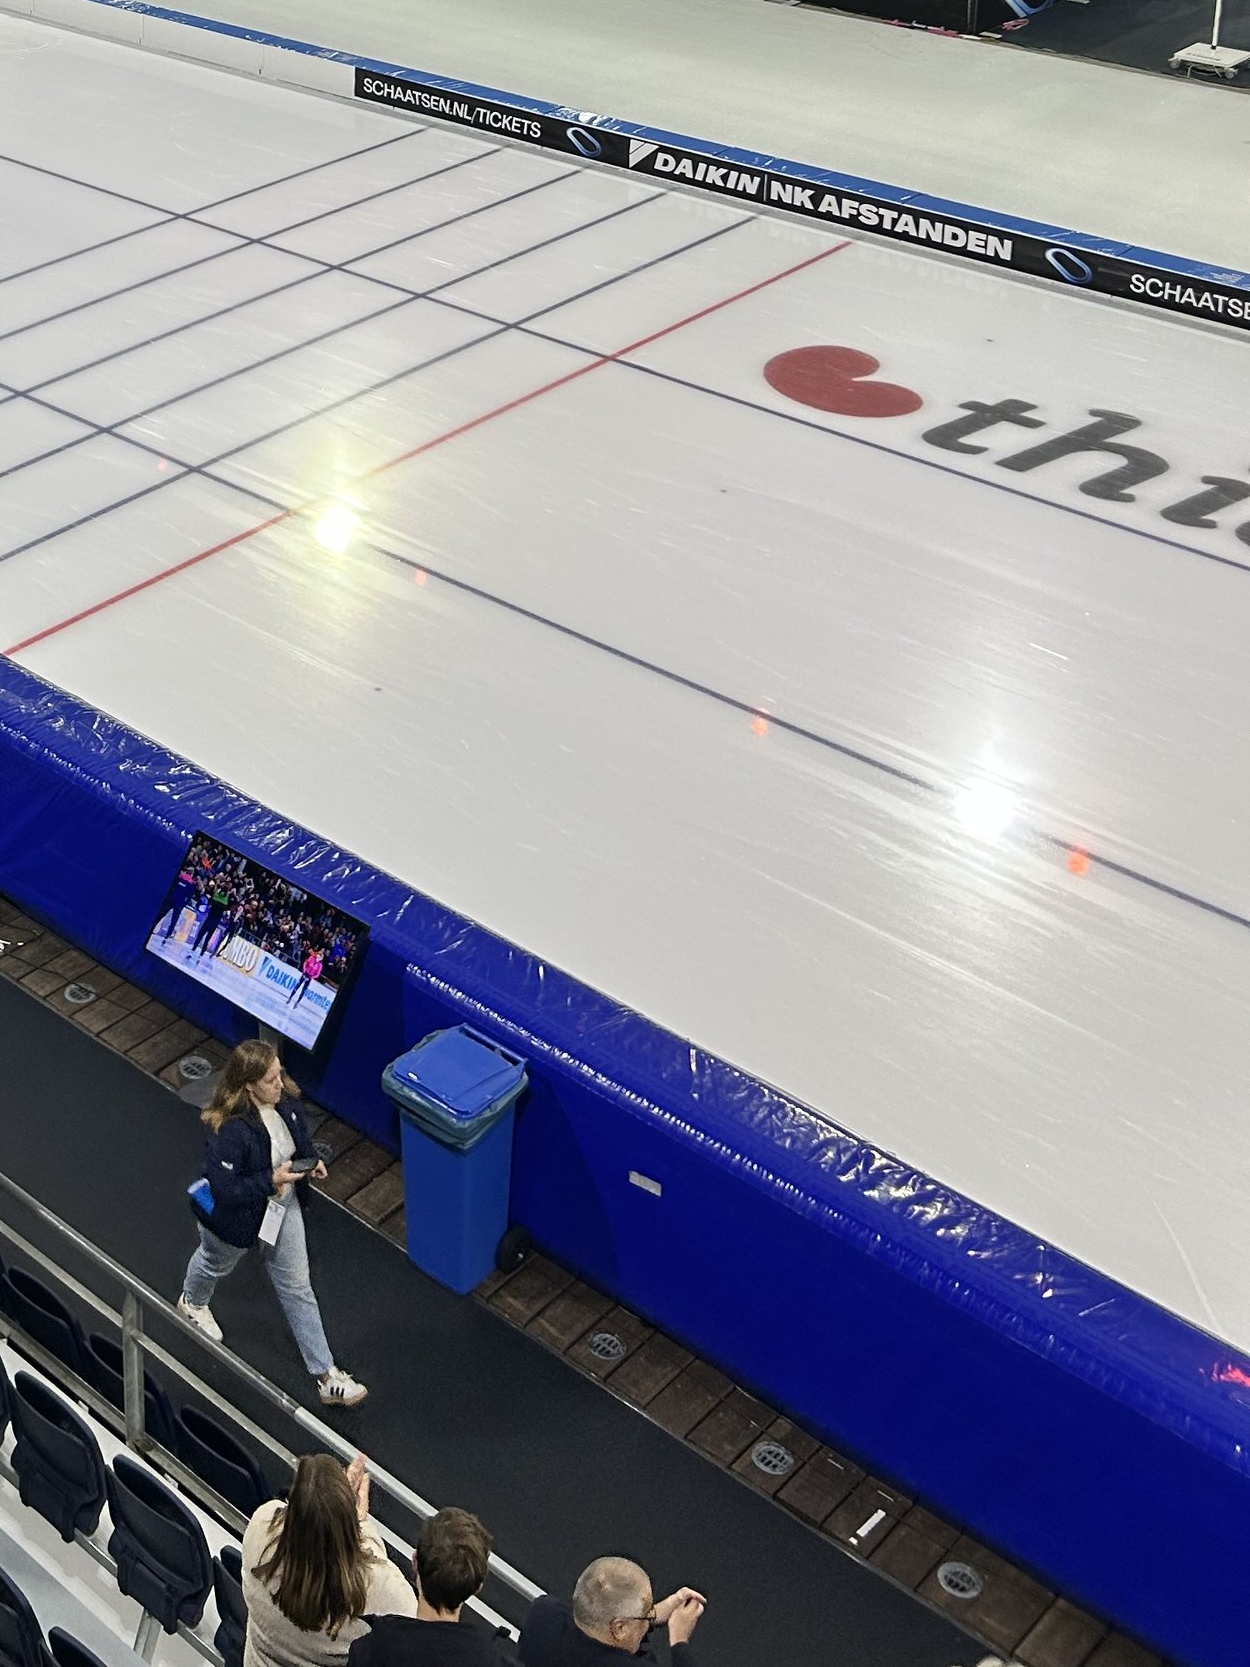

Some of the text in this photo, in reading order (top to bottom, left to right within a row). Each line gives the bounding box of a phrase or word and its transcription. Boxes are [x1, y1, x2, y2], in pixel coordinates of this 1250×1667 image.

[363, 77, 542, 139] SCHAATSEN.NL/TICKETS
[653, 152, 1013, 261] DAIKIN NK AFSTANDEN
